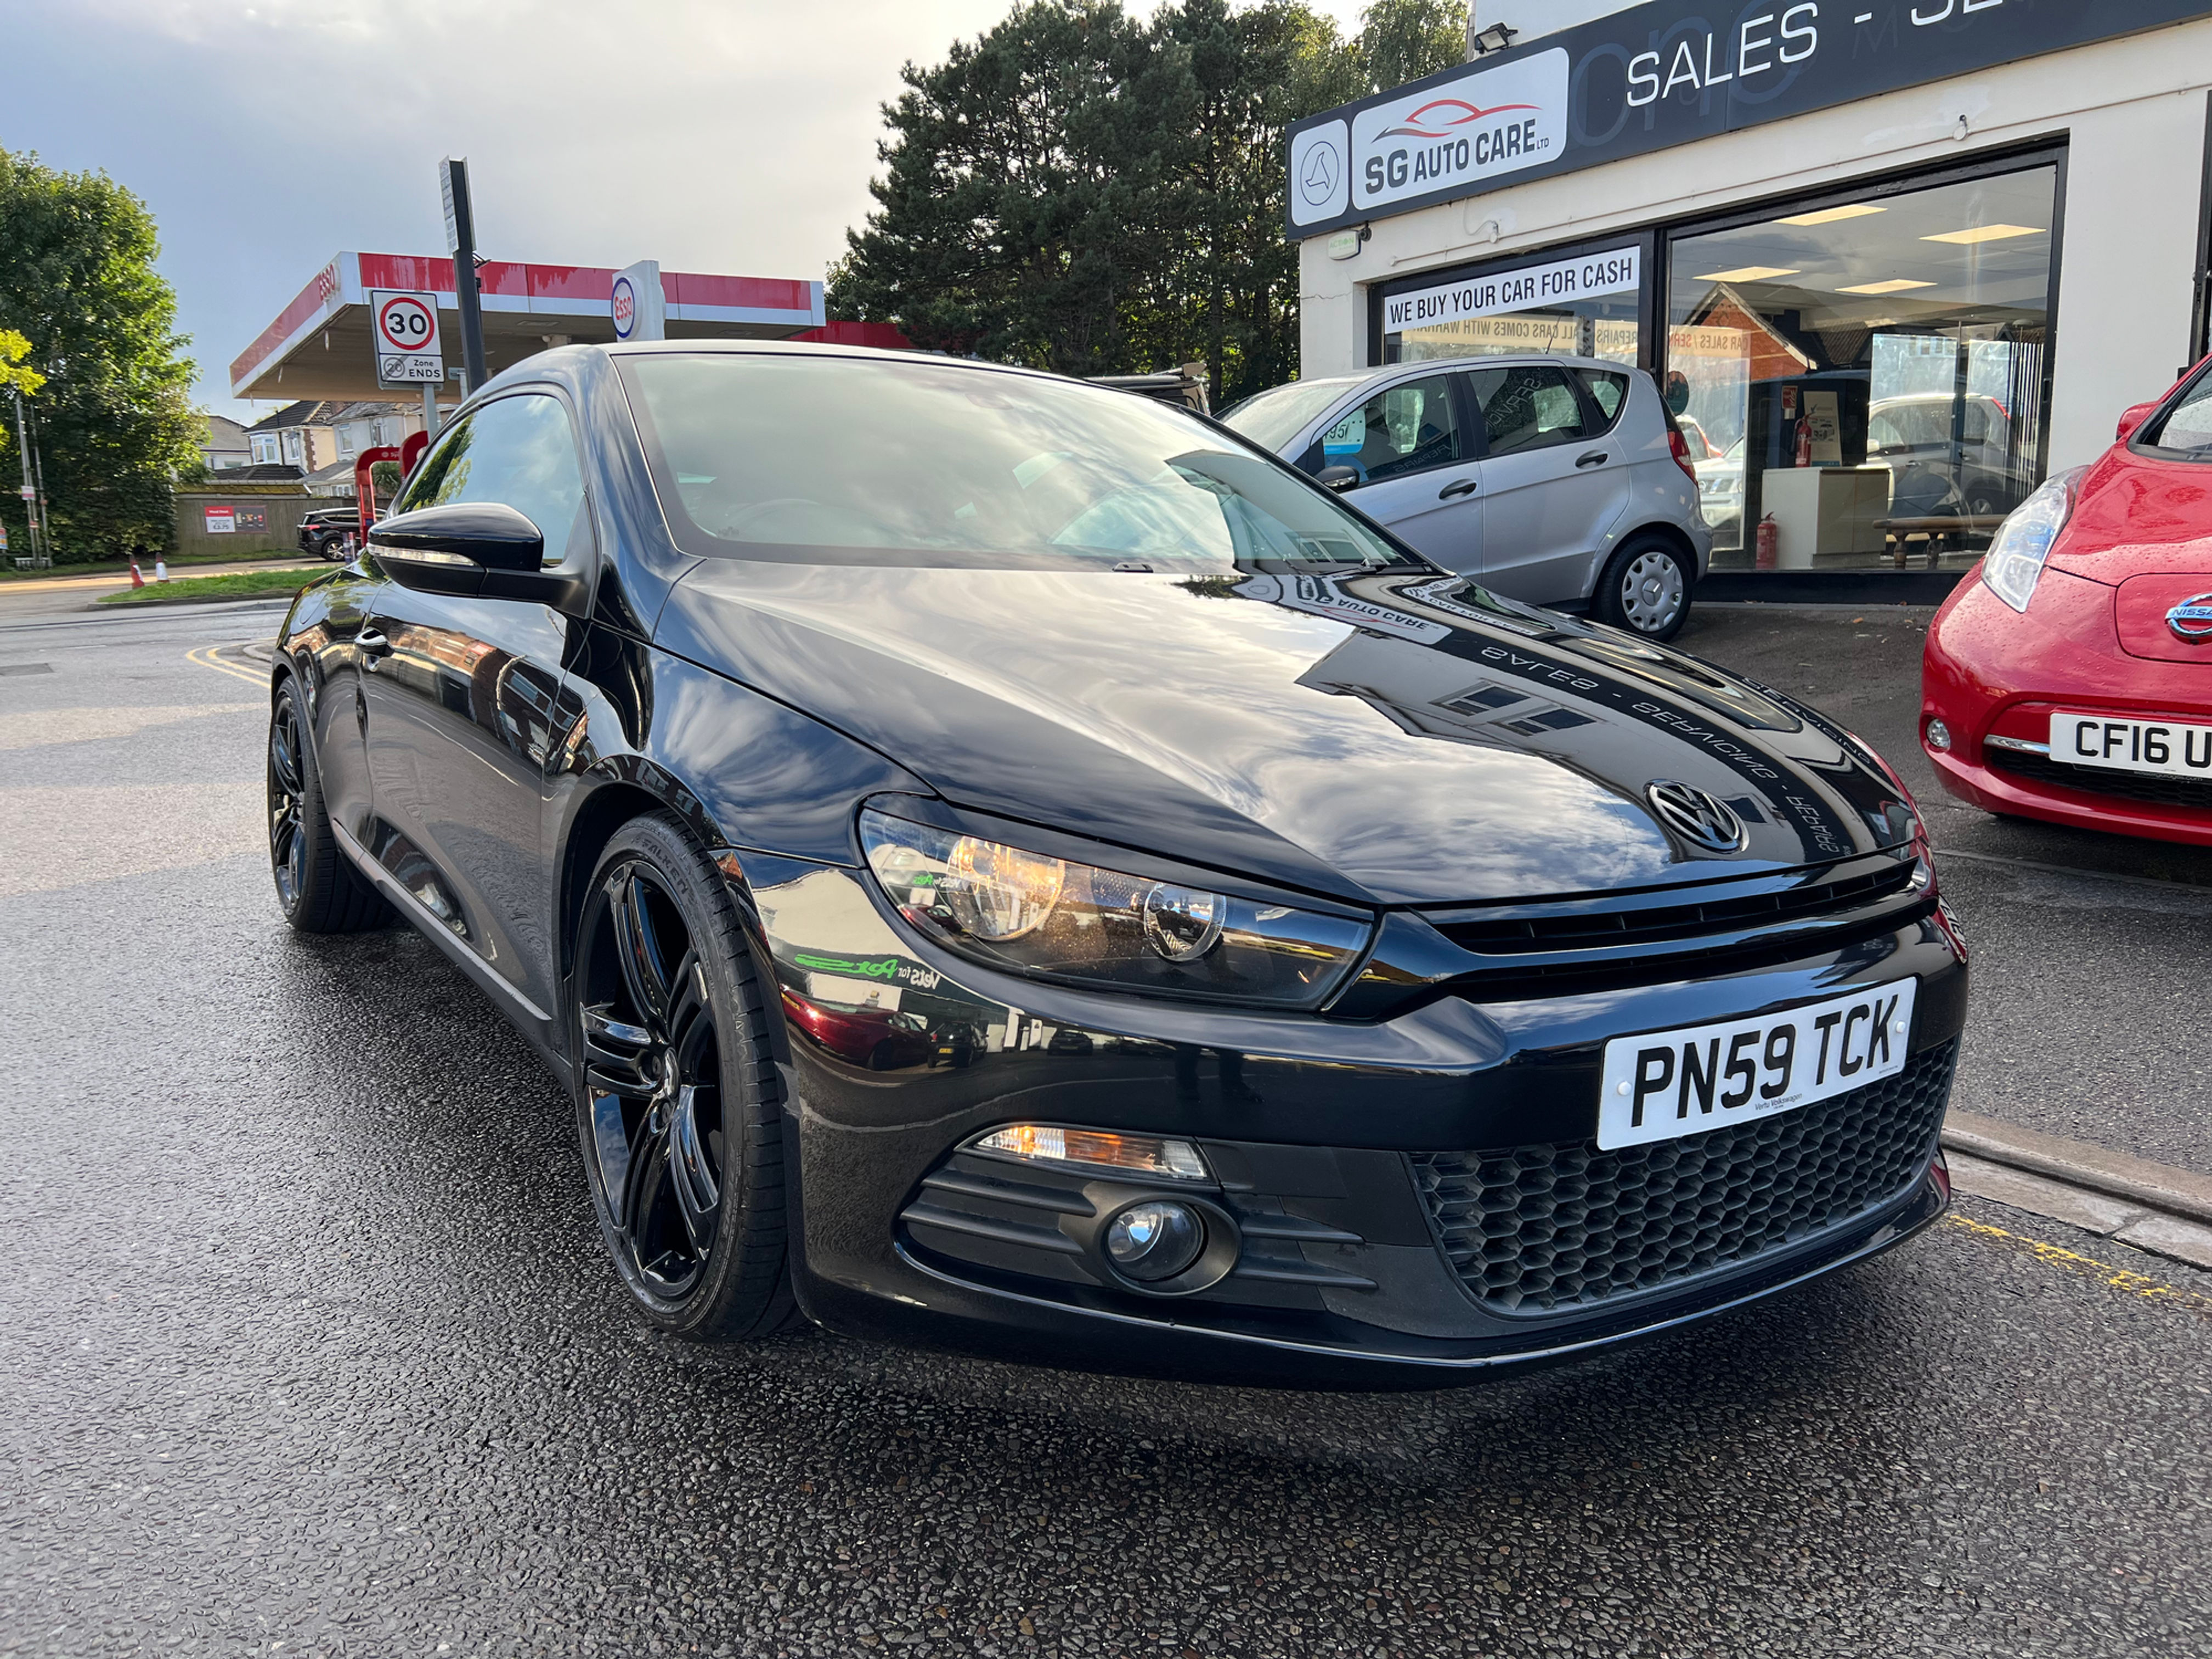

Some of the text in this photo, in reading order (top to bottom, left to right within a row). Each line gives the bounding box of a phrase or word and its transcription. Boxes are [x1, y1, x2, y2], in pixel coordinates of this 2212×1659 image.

[1626, 2, 1818, 107] SALES
[1365, 119, 1549, 194] SG AUTO CARE LTD
[1390, 257, 1632, 324] WE BUY YOUR CAR FOR CASH
[388, 313, 427, 335] 30
[386, 363, 403, 373] 20
[409, 369, 441, 378] ENDS
[2075, 720, 2170, 764] CF16
[1630, 994, 1899, 1128] PN59 TCK
